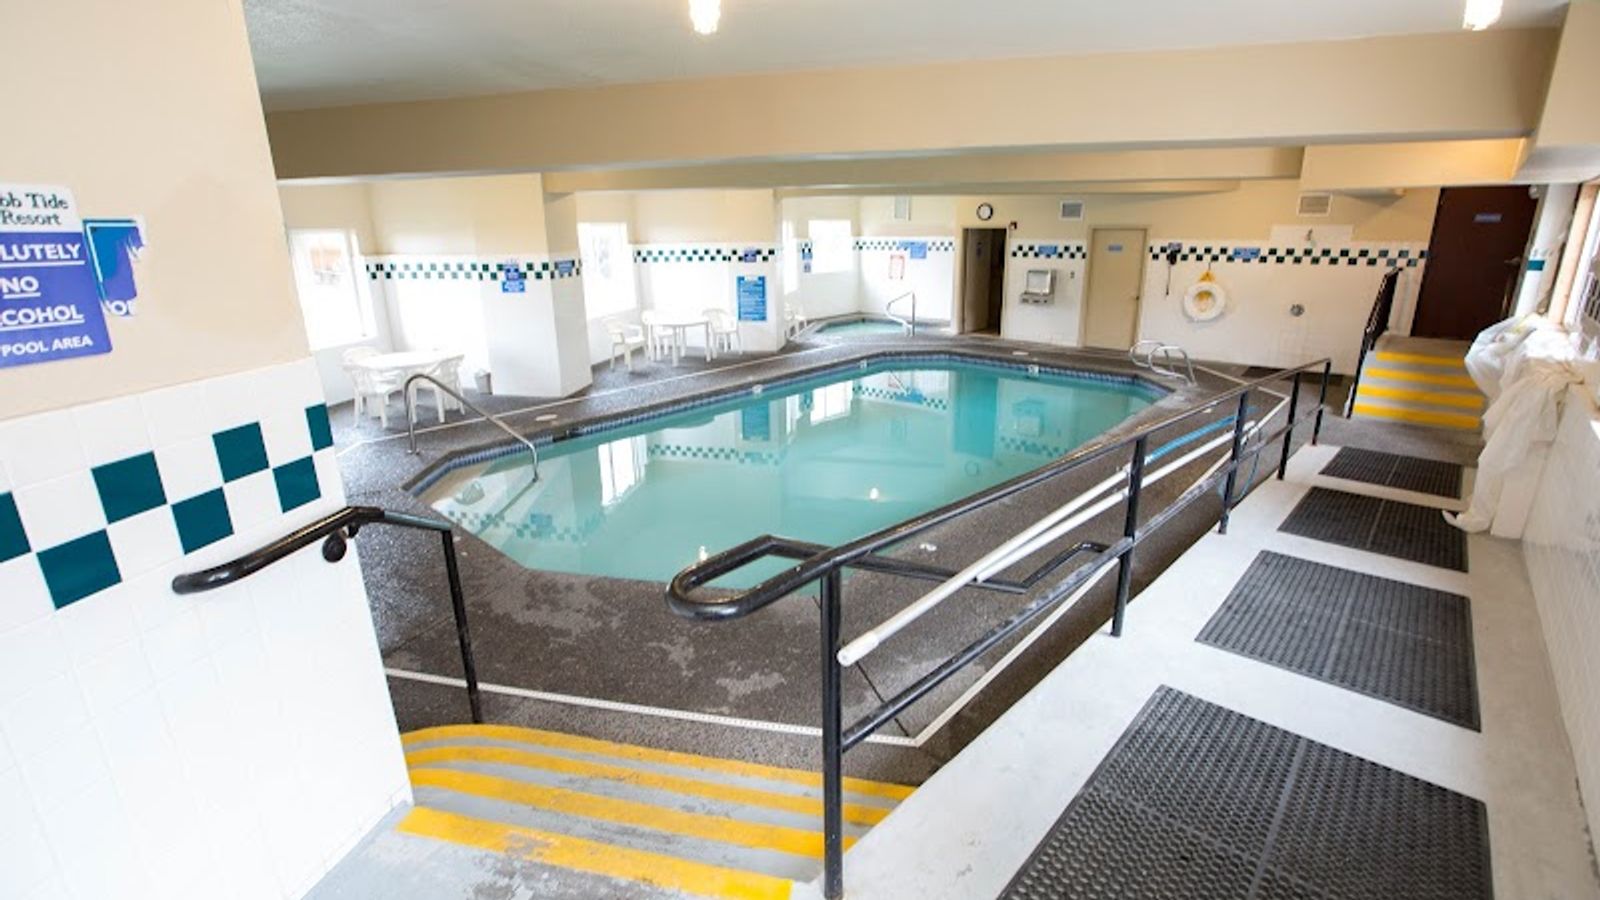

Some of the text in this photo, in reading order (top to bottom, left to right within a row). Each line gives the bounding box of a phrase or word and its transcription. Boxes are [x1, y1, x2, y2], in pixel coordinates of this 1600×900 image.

[25, 192, 69, 209] Tide
[1, 210, 62, 226] Resort
[0, 276, 39, 293] NO
[0, 304, 83, 326] COHOL
[1, 334, 94, 357] POOL AREA
